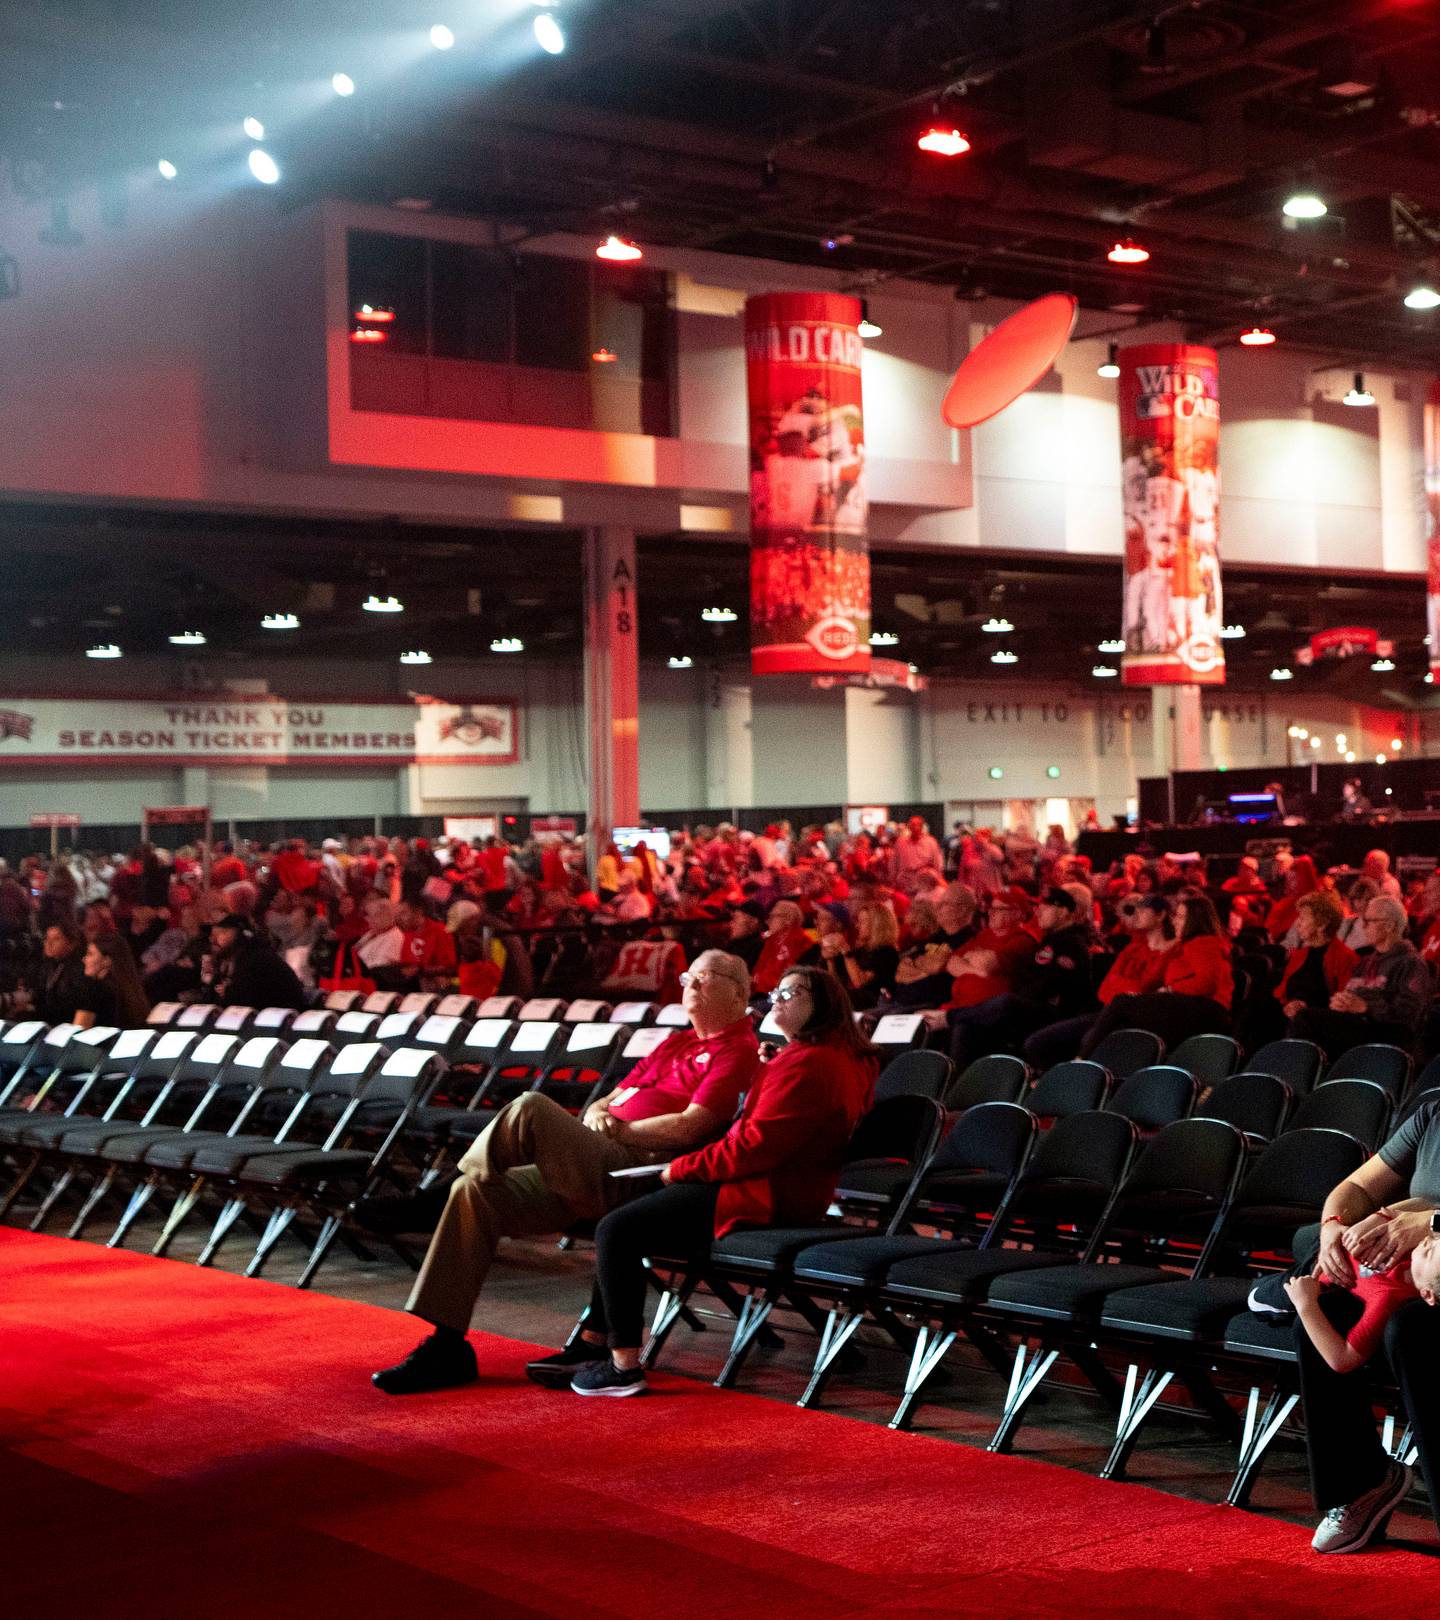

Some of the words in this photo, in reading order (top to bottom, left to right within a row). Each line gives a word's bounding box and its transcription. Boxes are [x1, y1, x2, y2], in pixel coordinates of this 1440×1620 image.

[815, 327, 862, 368] CAR
[164, 706, 261, 726] THANK
[271, 708, 325, 727] YOU
[966, 701, 1022, 723] EXIT
[1042, 702, 1069, 723] TO
[58, 730, 176, 748] SEASON
[185, 731, 284, 748] TICKET
[293, 731, 416, 748] MEMBERS
